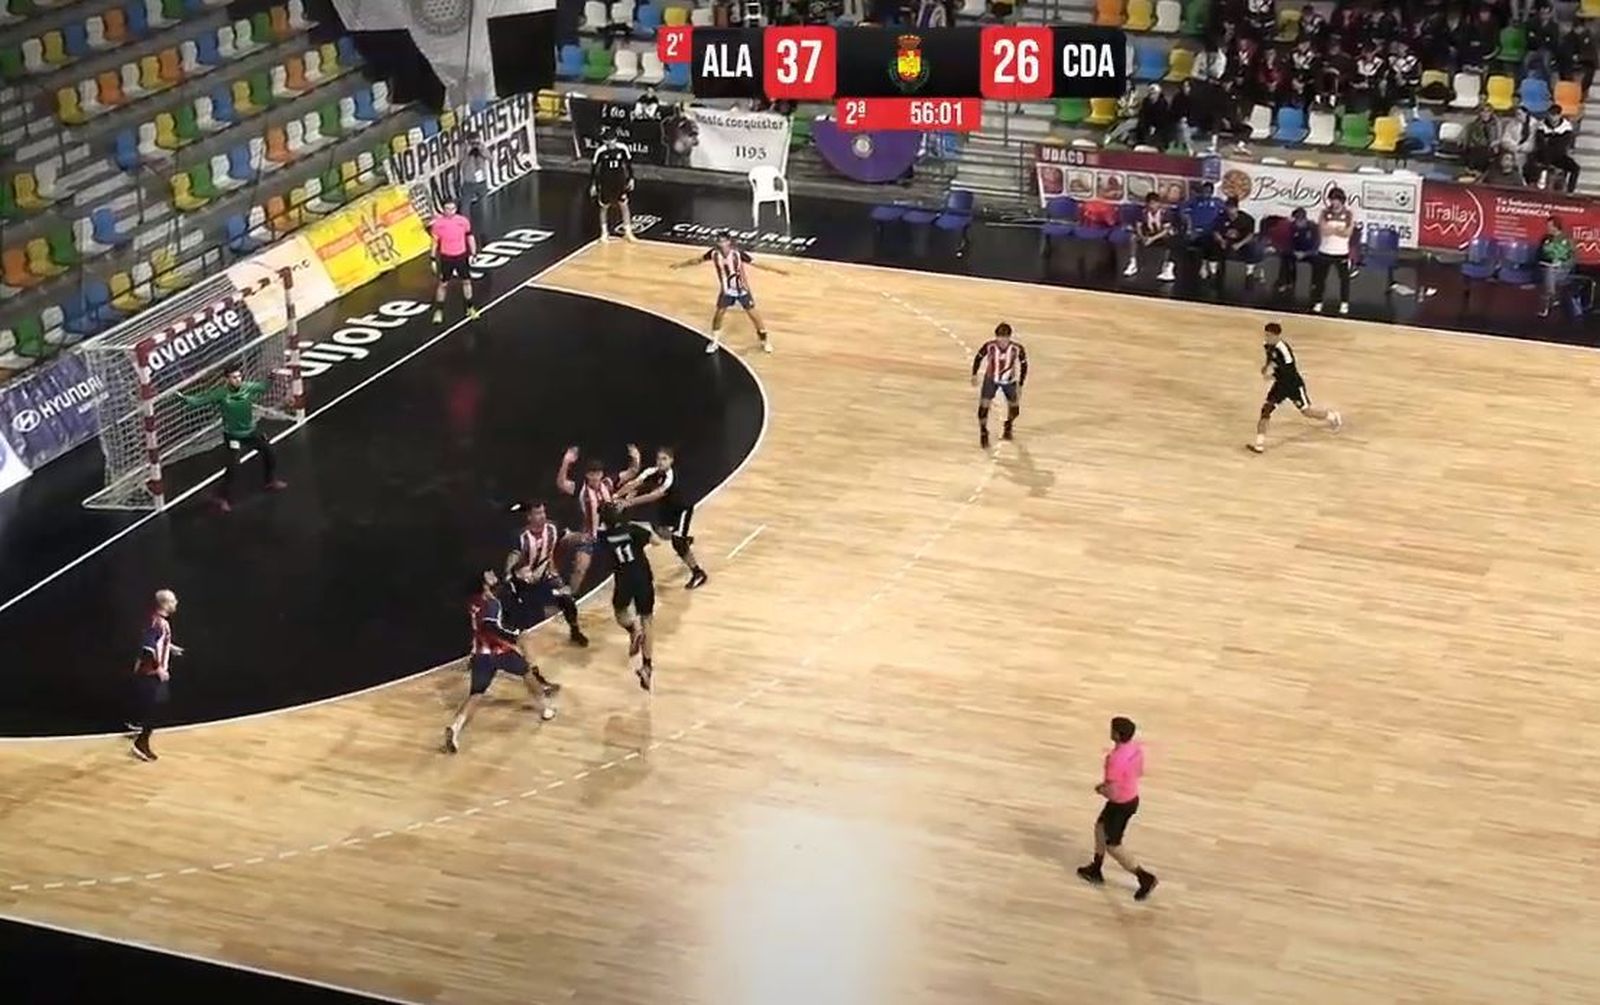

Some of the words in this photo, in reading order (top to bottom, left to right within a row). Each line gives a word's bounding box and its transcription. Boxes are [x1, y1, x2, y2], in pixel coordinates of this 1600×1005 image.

[475, 94, 530, 142] HASTA
[468, 228, 556, 279] ena
[147, 308, 241, 370] avarrete
[297, 300, 432, 378] uijote
[38, 374, 104, 419] HYUNDAI
